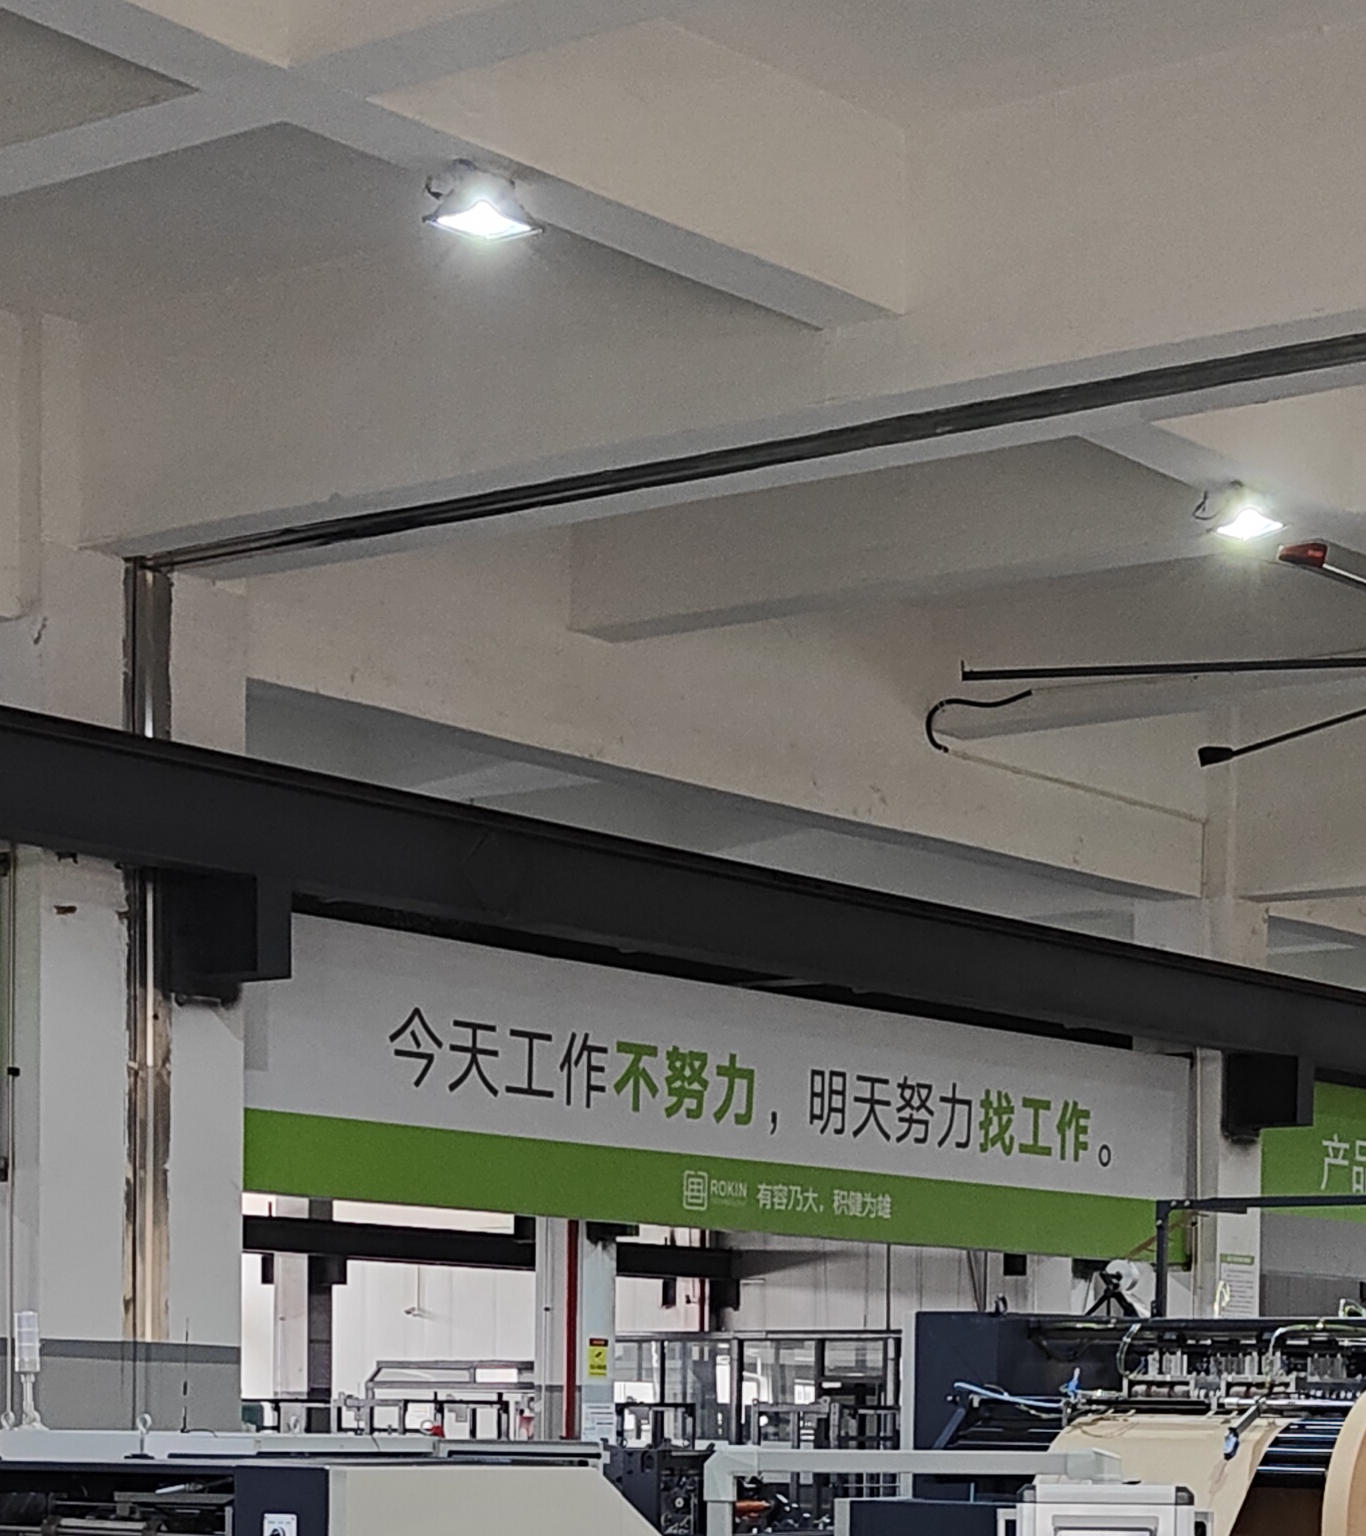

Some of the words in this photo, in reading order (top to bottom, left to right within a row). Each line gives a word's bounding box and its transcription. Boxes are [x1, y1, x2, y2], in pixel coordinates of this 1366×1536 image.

[388, 1006, 1113, 1168] 今天工作不努力，明天努力找工作。
[710, 1179, 748, 1198] ROKIN
